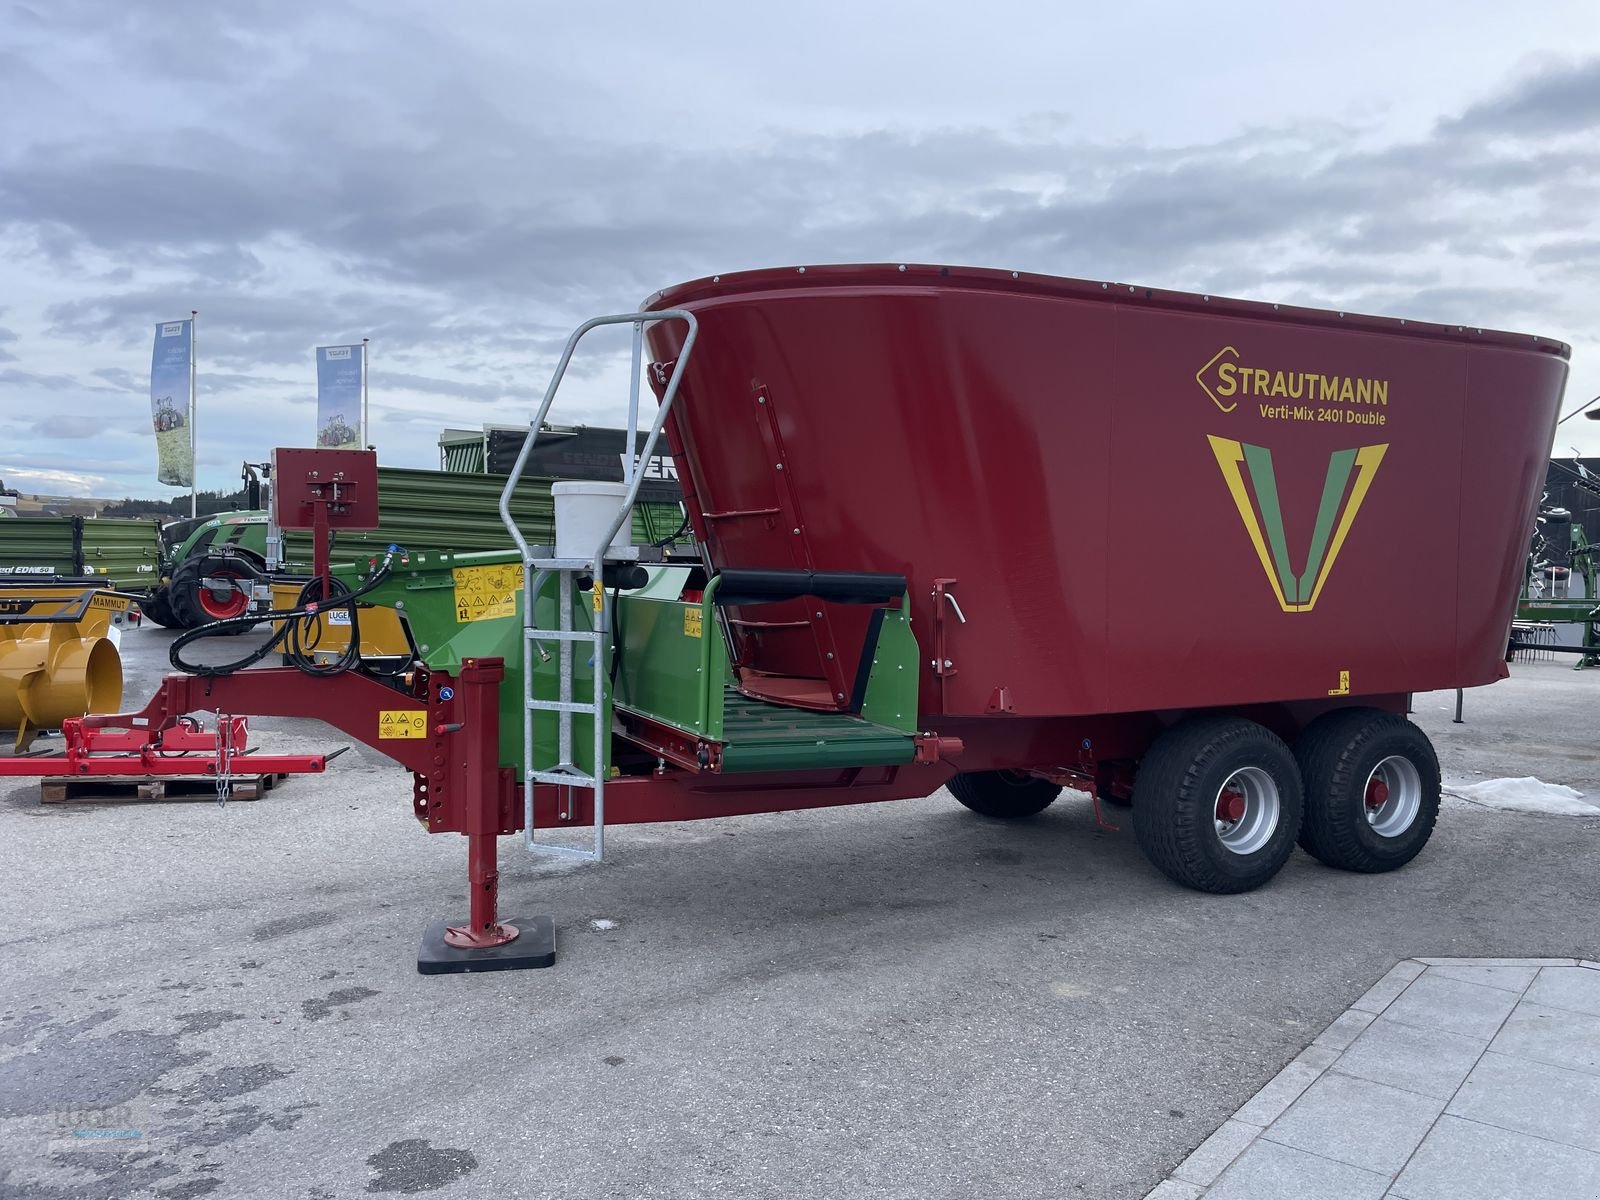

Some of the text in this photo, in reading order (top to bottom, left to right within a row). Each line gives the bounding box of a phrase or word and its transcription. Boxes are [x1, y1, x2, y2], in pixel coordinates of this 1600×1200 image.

[1216, 362, 1389, 406] STRAUTMANN
[1259, 403, 1387, 426] Verti-Mix 2401 Double
[93, 596, 126, 609] MAMMUT
